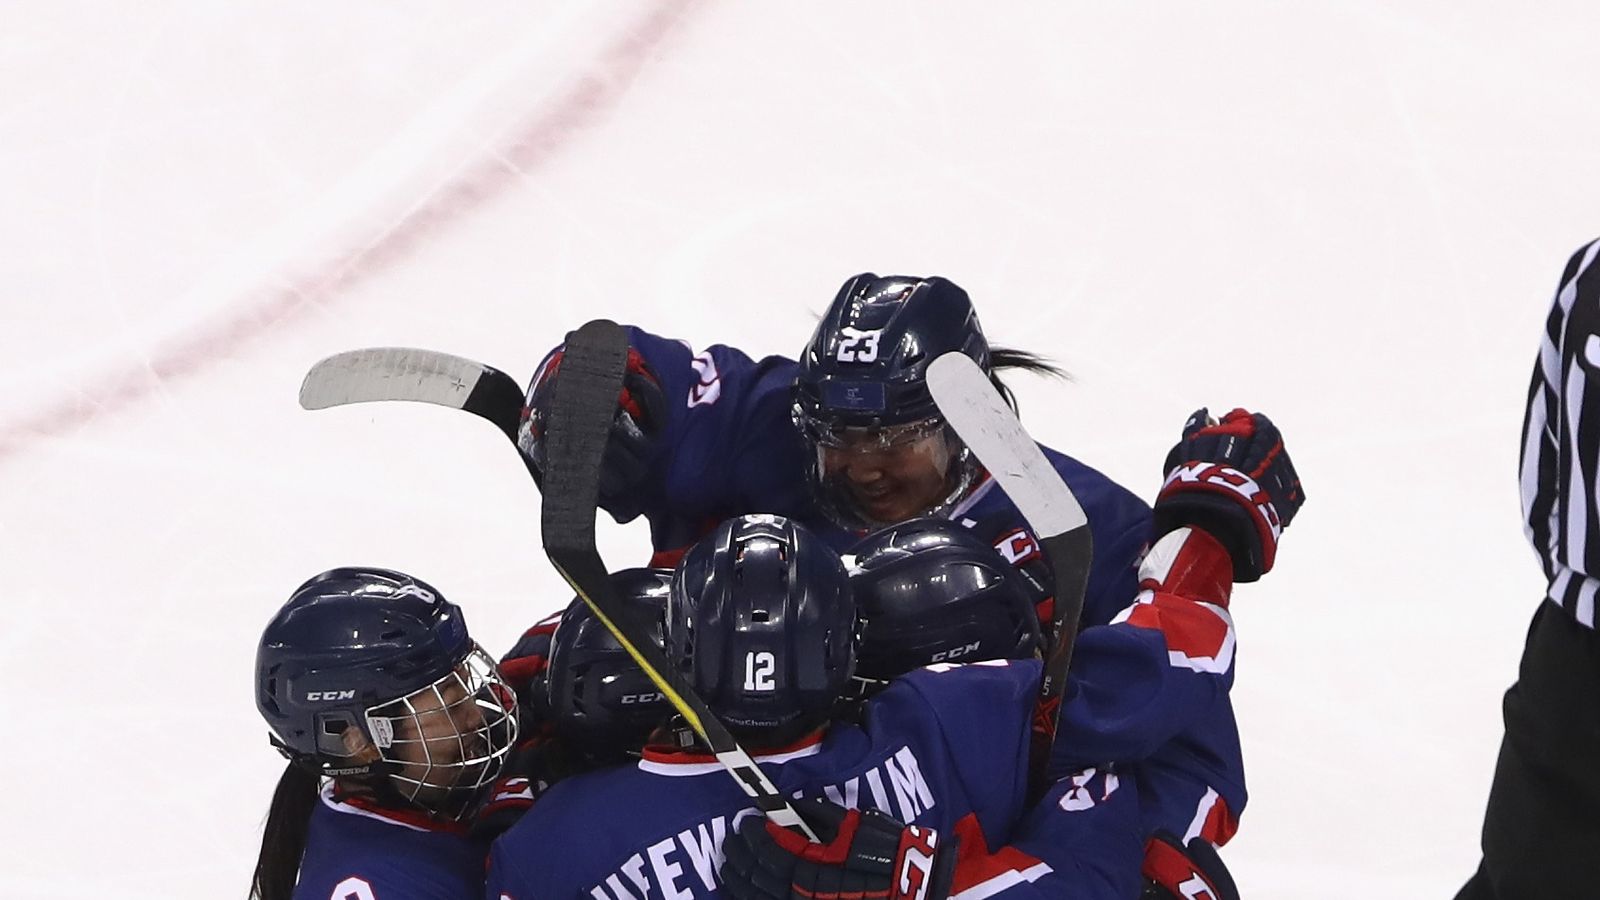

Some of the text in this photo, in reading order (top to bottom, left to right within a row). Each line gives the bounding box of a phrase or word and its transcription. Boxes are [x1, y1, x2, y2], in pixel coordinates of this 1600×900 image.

[837, 327, 881, 362] 23
[931, 640, 981, 662] CCM
[744, 652, 775, 691] 12
[306, 689, 356, 701] CCM
